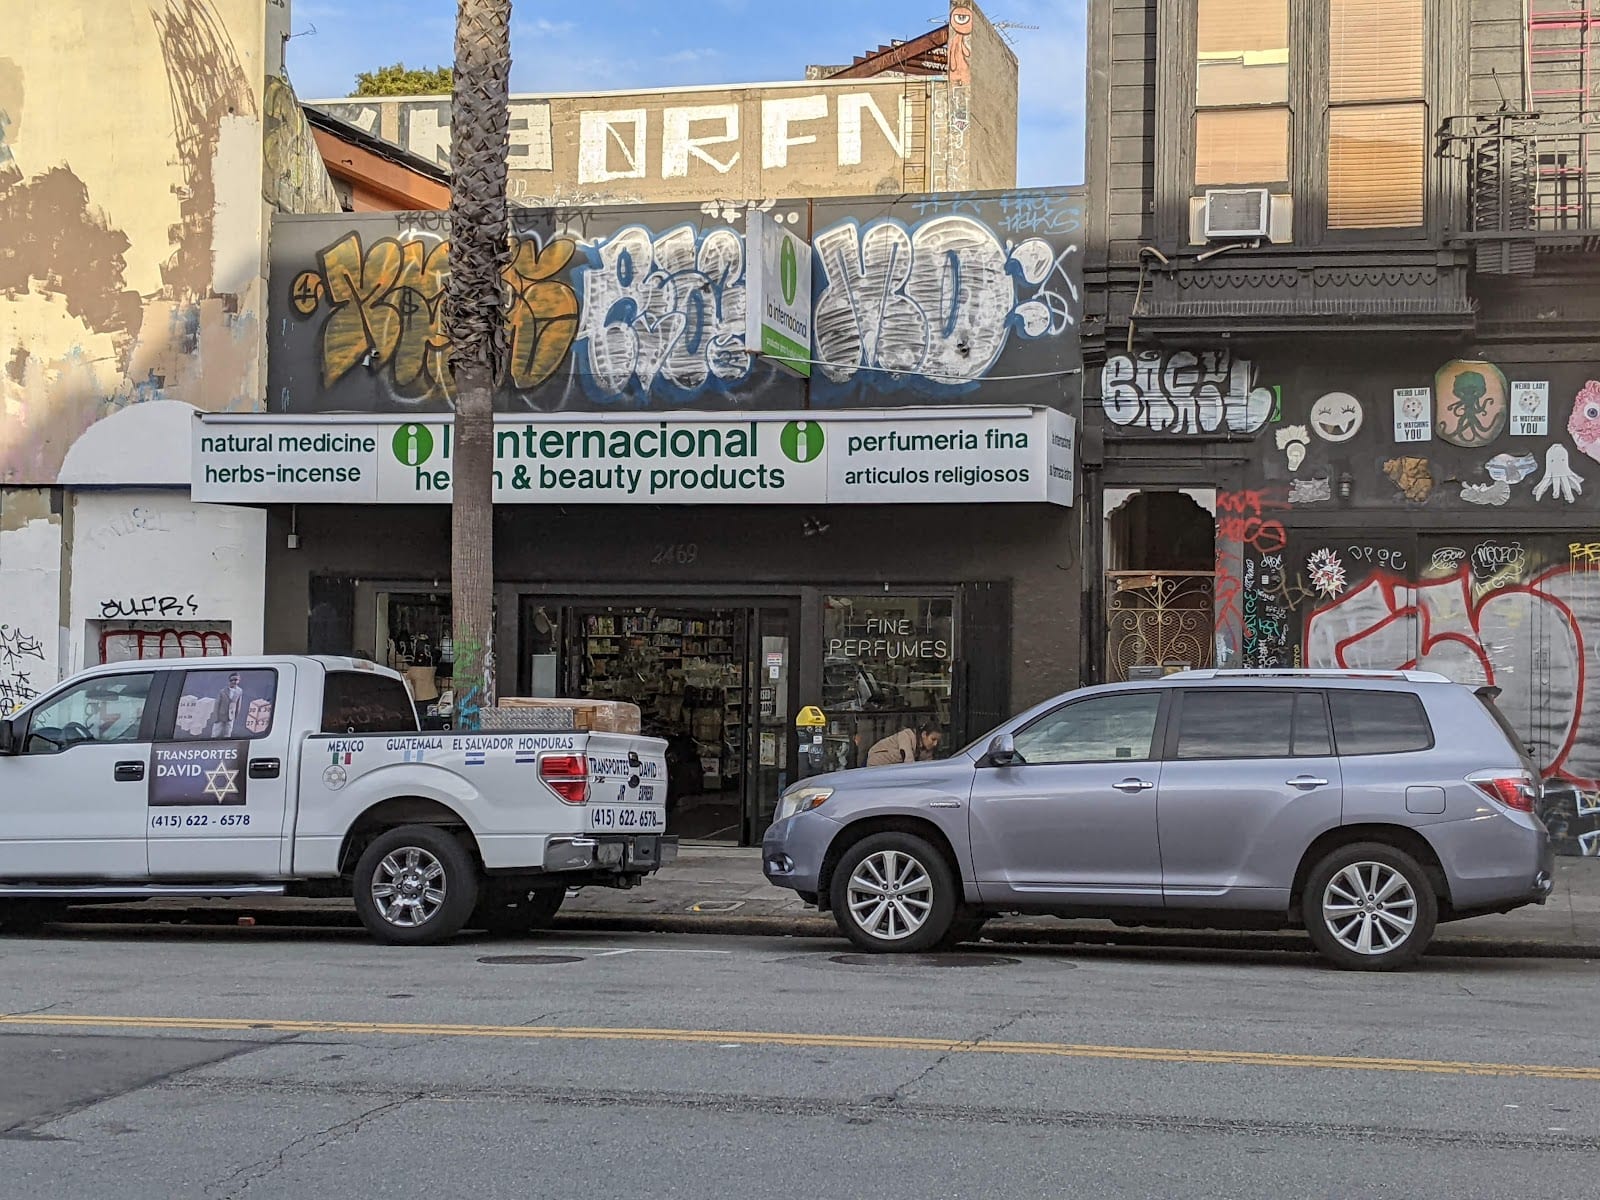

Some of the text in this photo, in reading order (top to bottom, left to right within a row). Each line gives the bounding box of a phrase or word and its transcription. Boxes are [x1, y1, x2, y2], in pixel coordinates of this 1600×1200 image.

[1404, 428, 1422, 440] YOU
[1520, 422, 1538, 434] YOU
[201, 433, 376, 452] natural medicine
[496, 422, 757, 459] nternacional
[848, 430, 977, 457] perfumeria
[984, 429, 1029, 449] fina
[205, 465, 361, 484] herbs-incense
[511, 464, 532, 490] &
[539, 463, 643, 493] beauty
[649, 463, 785, 494] products
[844, 467, 930, 485] articulos
[934, 465, 1030, 487] religiosos
[866, 618, 909, 636] FINE
[828, 639, 948, 660] PERFUMES
[327, 737, 574, 753] MEXICO GUATEMALA EL SALVADOR HONDURAS
[156, 749, 238, 761] TRANSPORTES
[156, 764, 202, 777] DAVID
[589, 757, 657, 778] TRANSPORTES DAVID
[151, 815, 182, 828] (415)
[185, 815, 209, 826] 622
[219, 814, 251, 826] 6578
[592, 808, 615, 829] (415)
